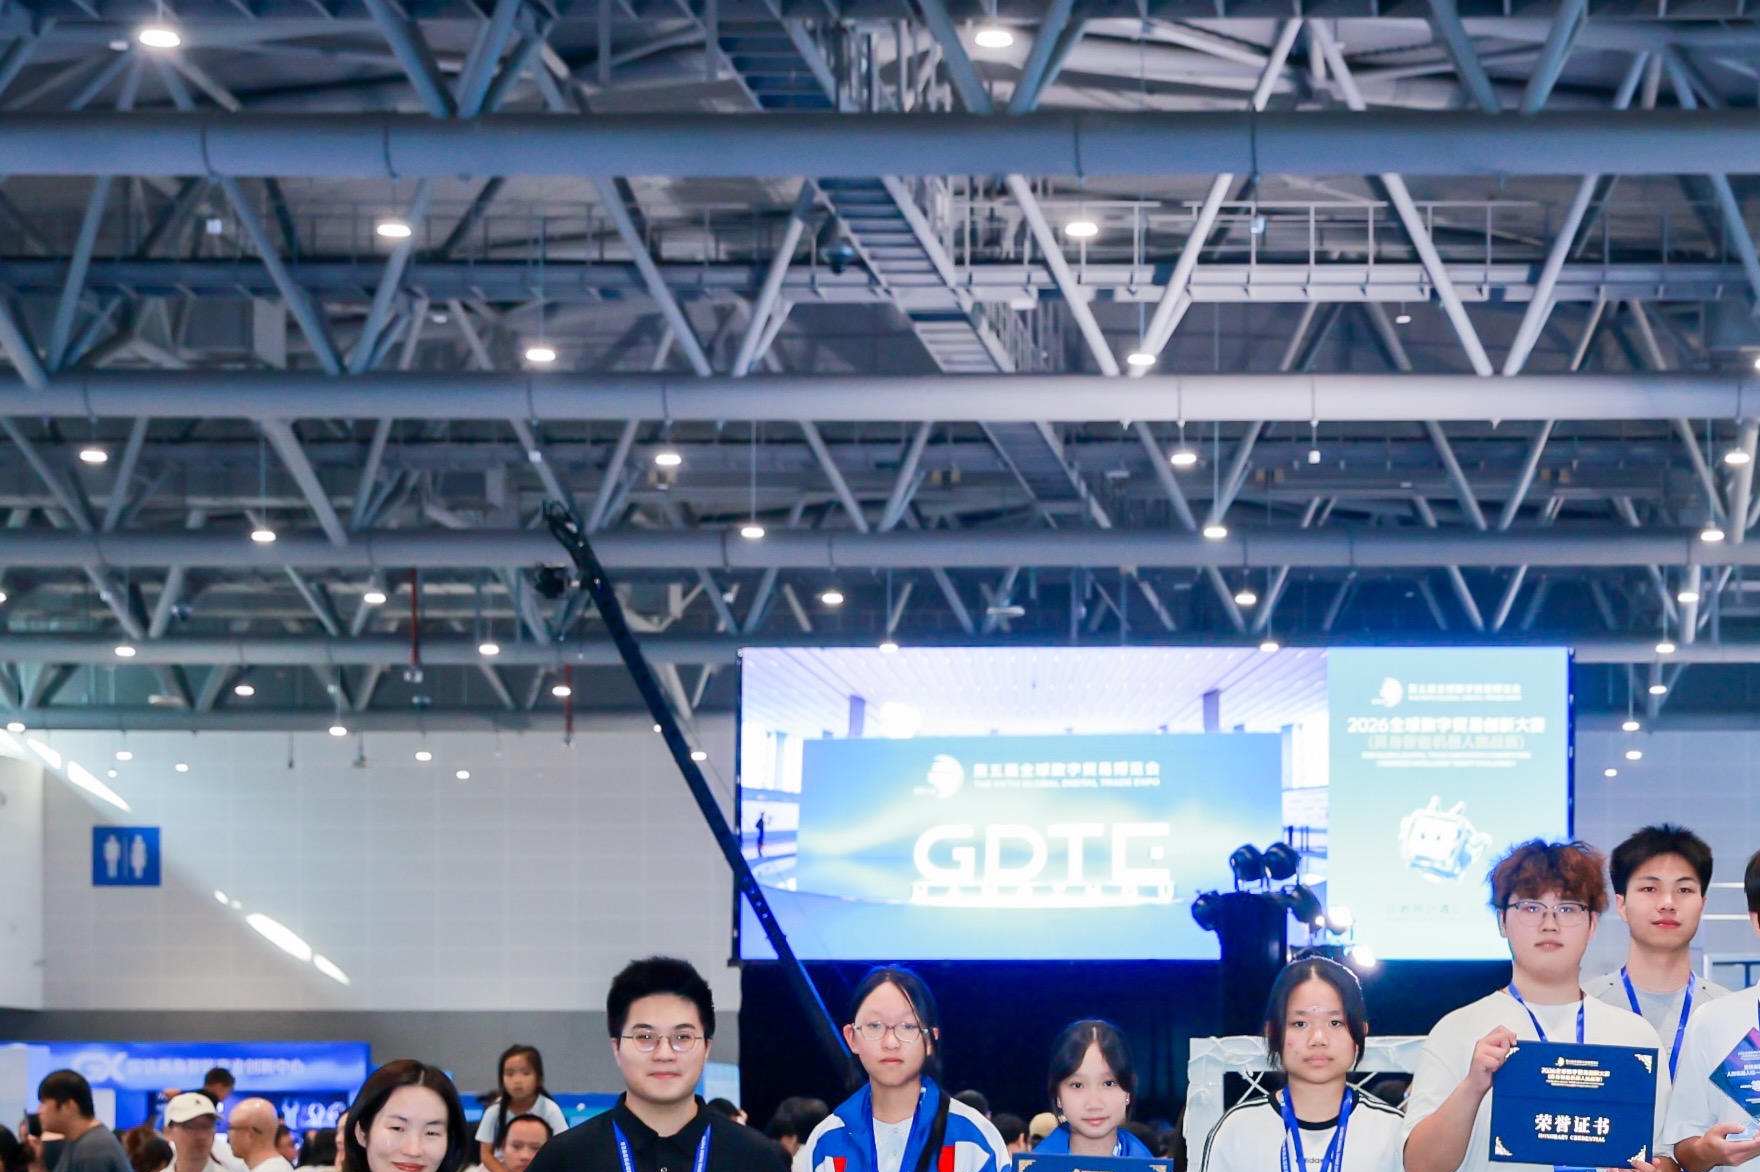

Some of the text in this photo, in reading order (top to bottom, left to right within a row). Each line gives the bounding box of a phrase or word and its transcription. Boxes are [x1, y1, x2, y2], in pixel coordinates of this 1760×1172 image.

[913, 823, 1171, 883] GDTE
[1534, 1113, 1610, 1136] 荣誉证书
